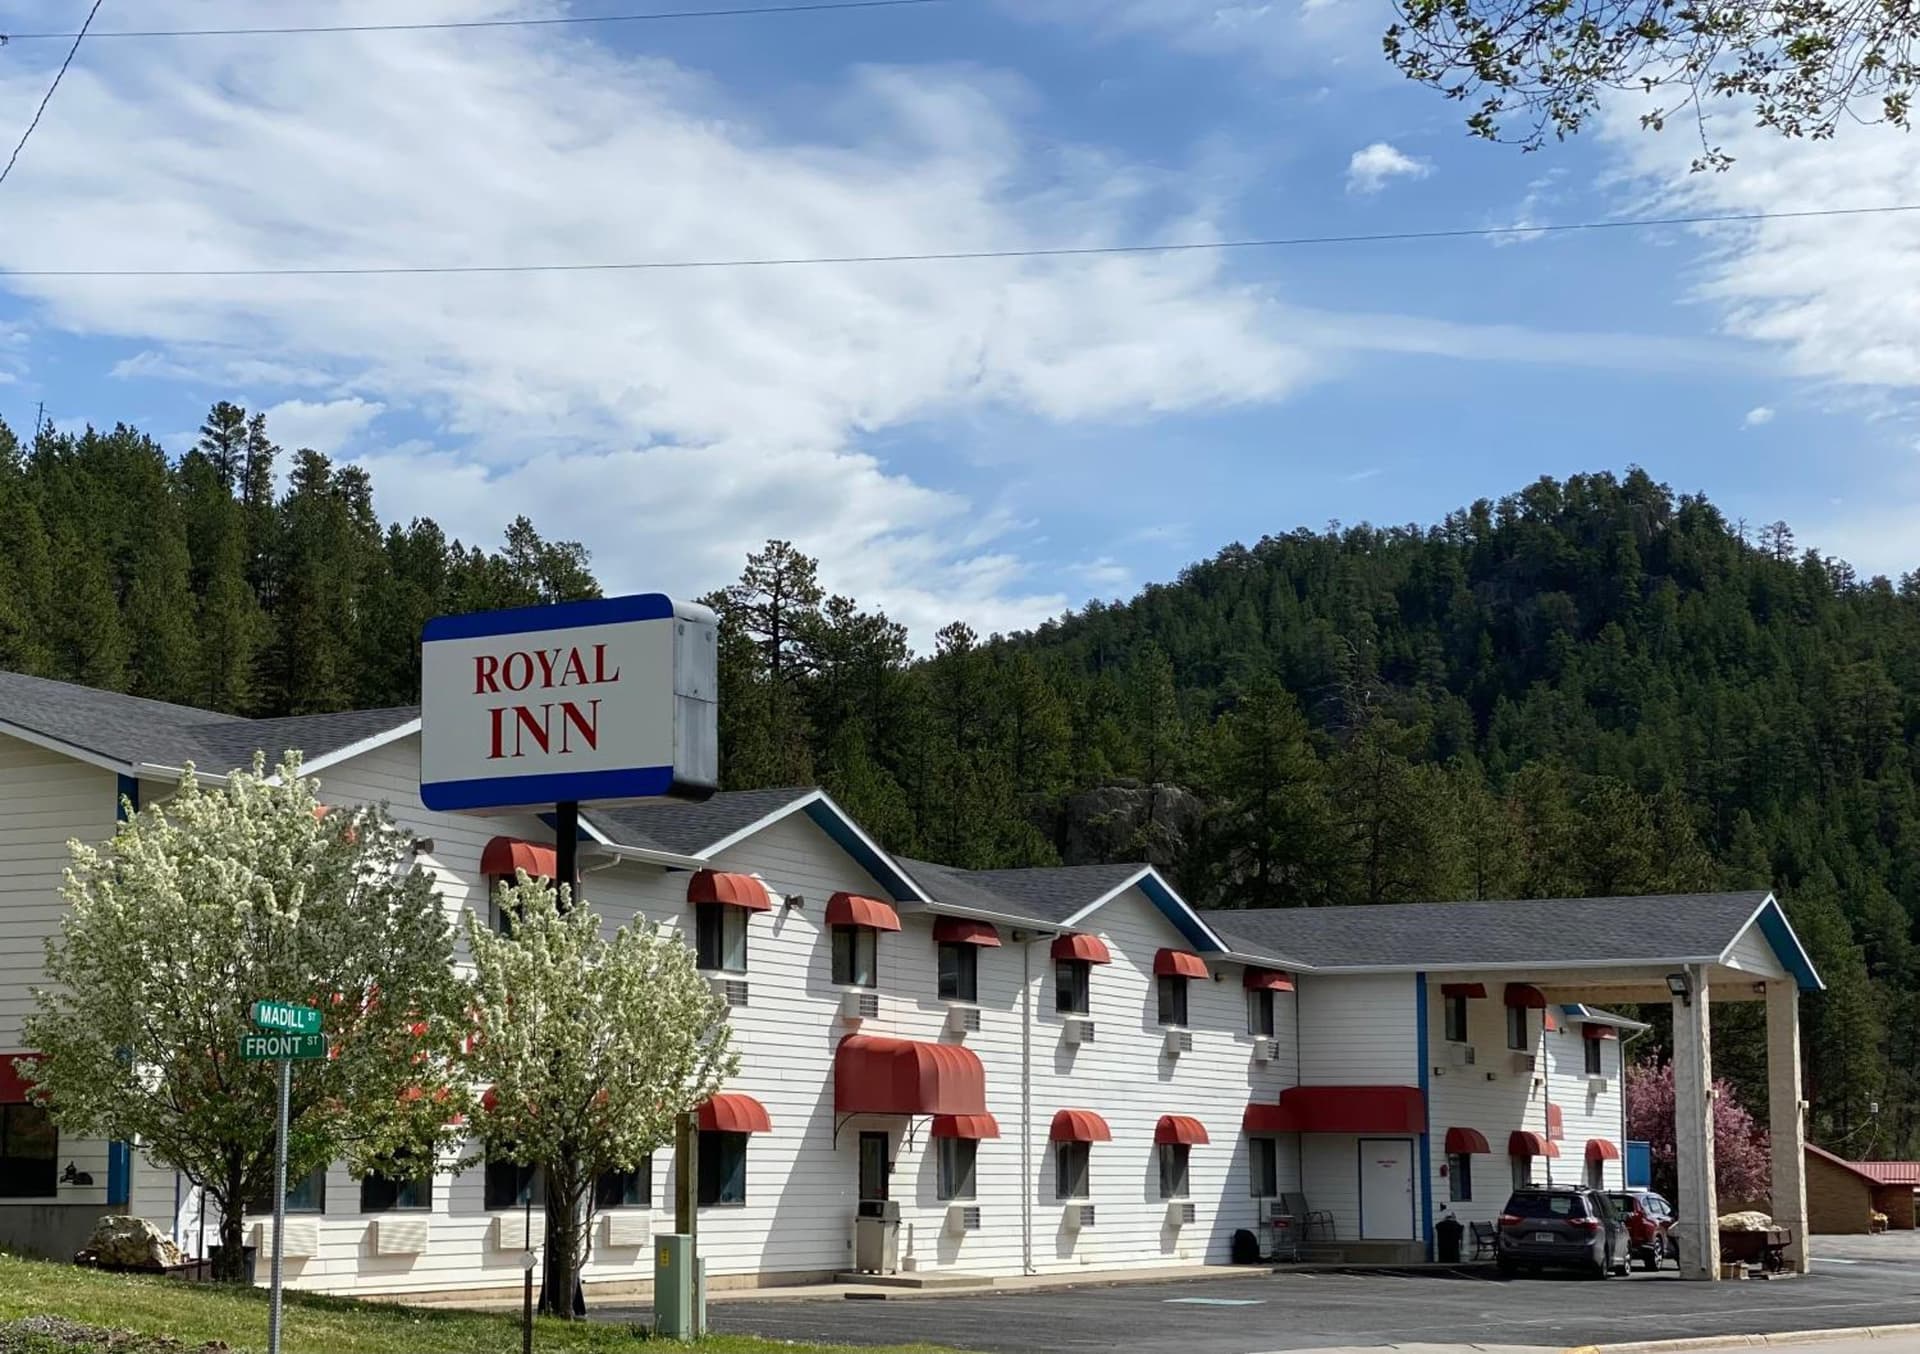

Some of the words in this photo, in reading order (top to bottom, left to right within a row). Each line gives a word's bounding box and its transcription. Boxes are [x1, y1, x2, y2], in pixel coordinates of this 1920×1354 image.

[472, 644, 621, 695] ROYAL
[486, 699, 602, 760] INN
[260, 1005, 304, 1028] MADILL
[308, 1012, 316, 1021] ST
[246, 1037, 302, 1056] FRONT
[307, 1036, 318, 1045] ST
